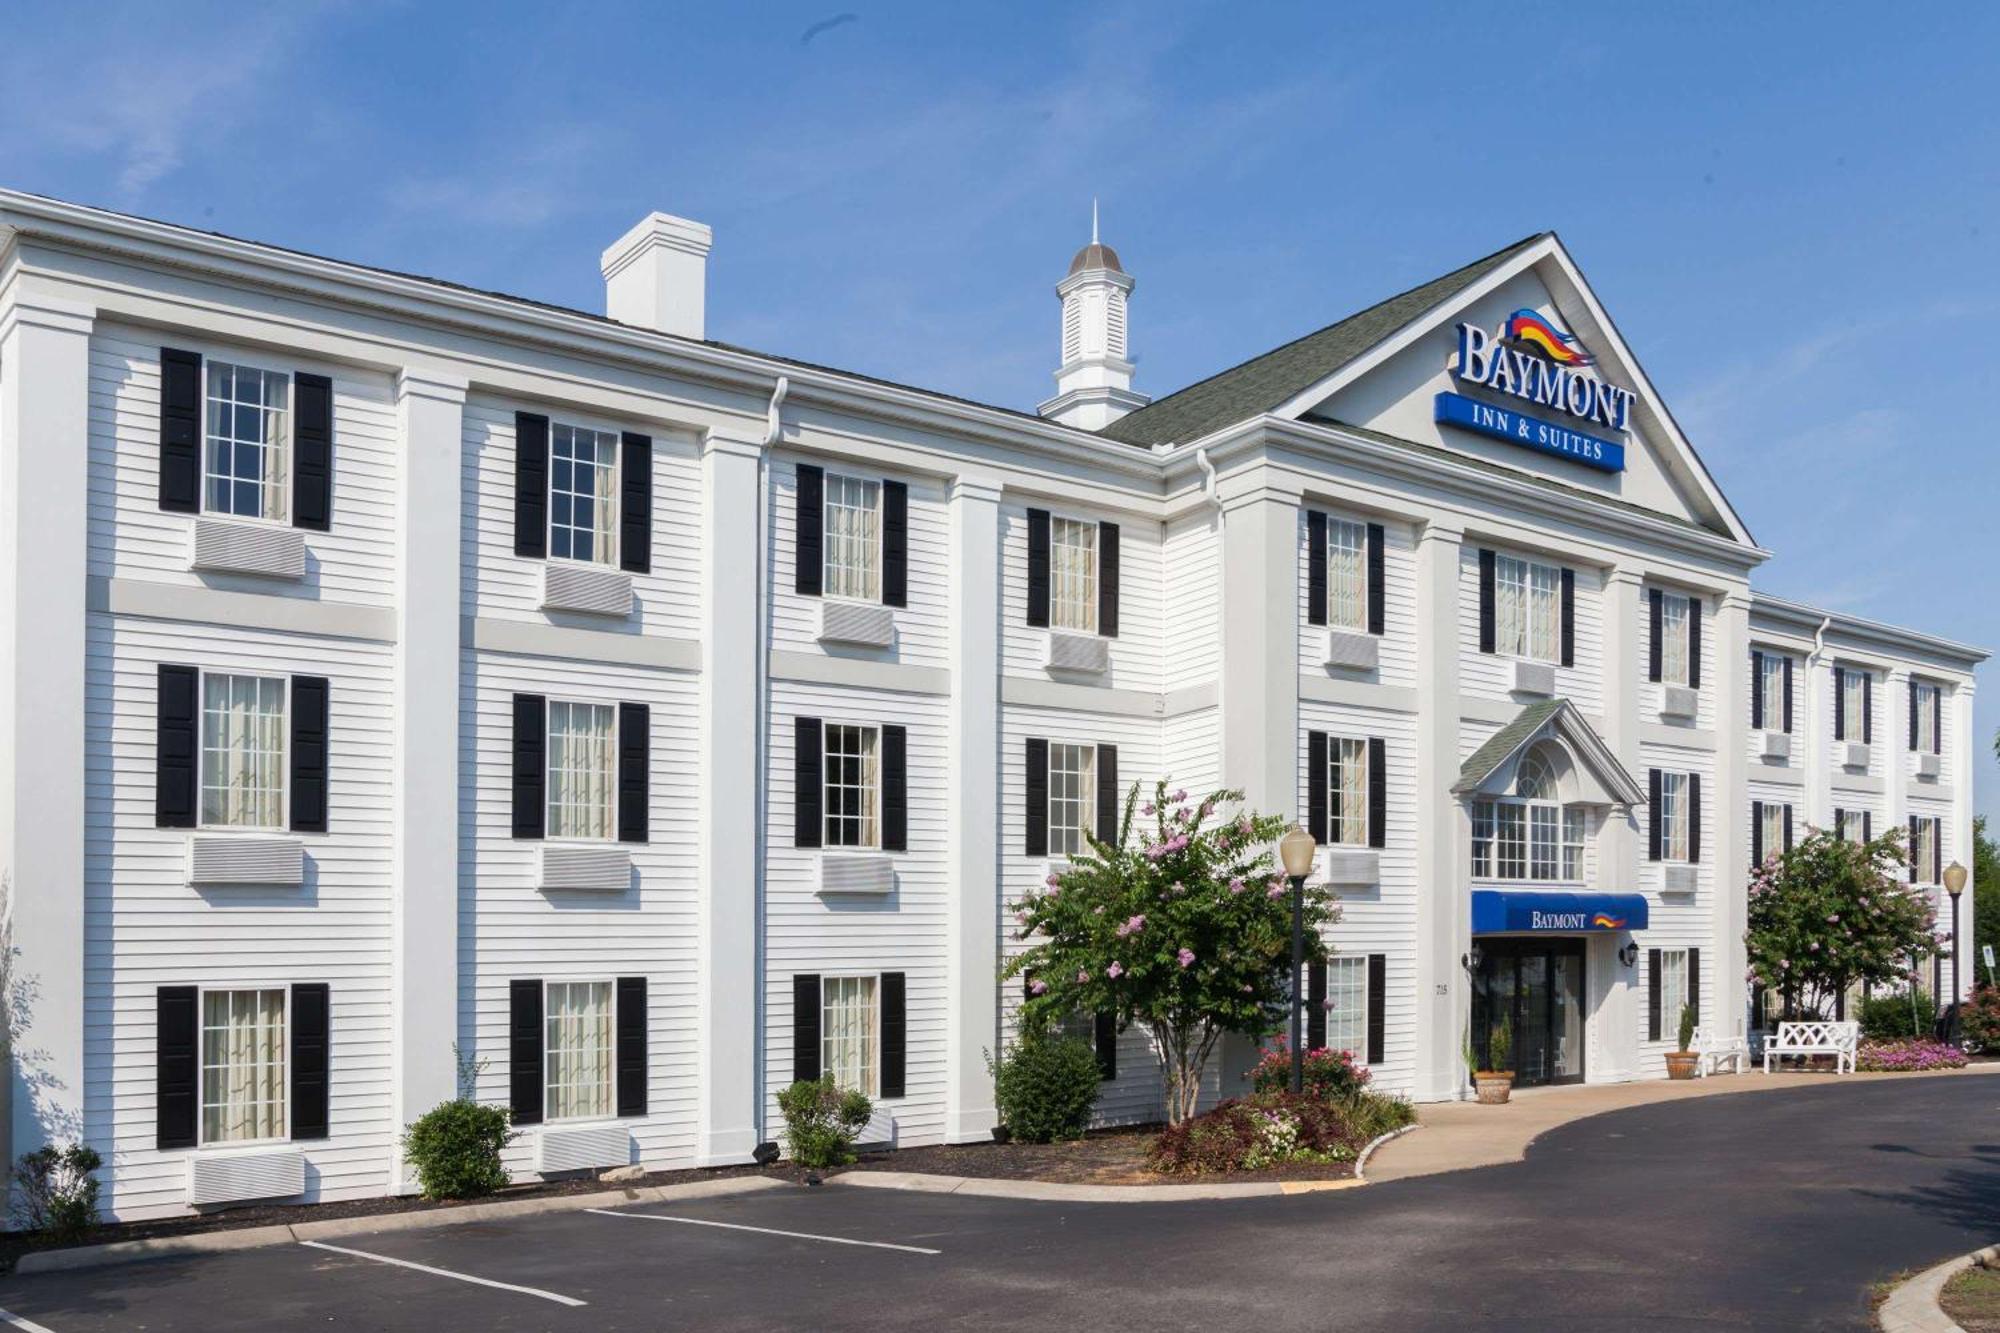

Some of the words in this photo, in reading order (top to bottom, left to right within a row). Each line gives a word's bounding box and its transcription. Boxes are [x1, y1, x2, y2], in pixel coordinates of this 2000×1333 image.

[1457, 322, 1636, 432] BAYMONT
[1473, 405, 1508, 431] INN
[1518, 420, 1530, 438] &
[1539, 426, 1602, 459] SUITES
[1532, 911, 1586, 928] BAYMONT
